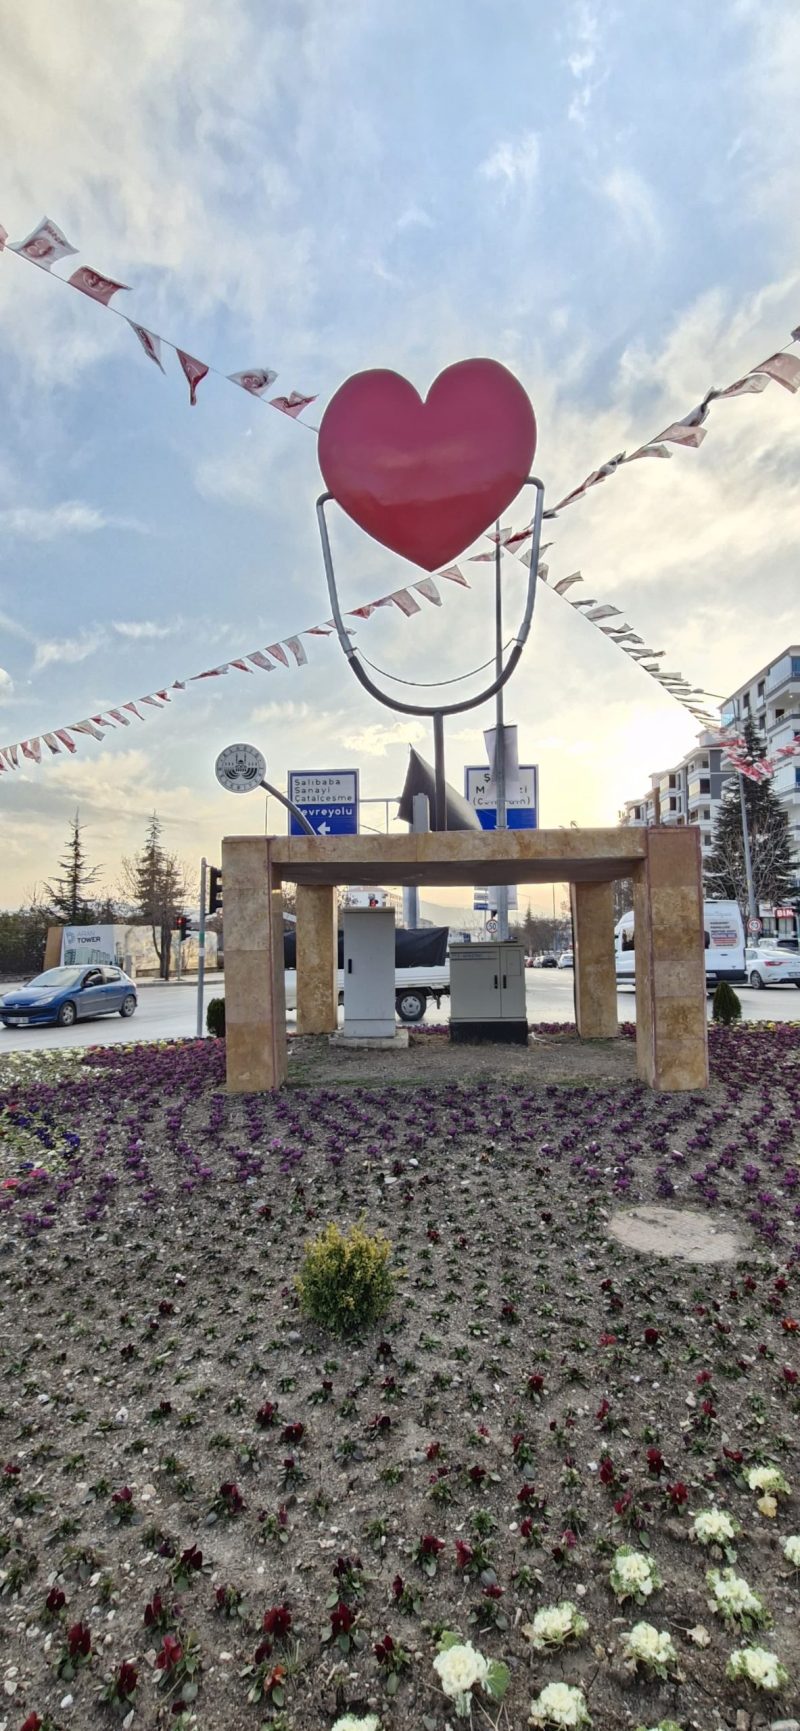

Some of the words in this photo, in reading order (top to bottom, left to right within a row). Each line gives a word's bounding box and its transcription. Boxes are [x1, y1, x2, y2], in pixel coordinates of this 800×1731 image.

[299, 806, 353, 818] evreyolu
[489, 922, 497, 931] 50
[77, 936, 101, 944] TOWER
